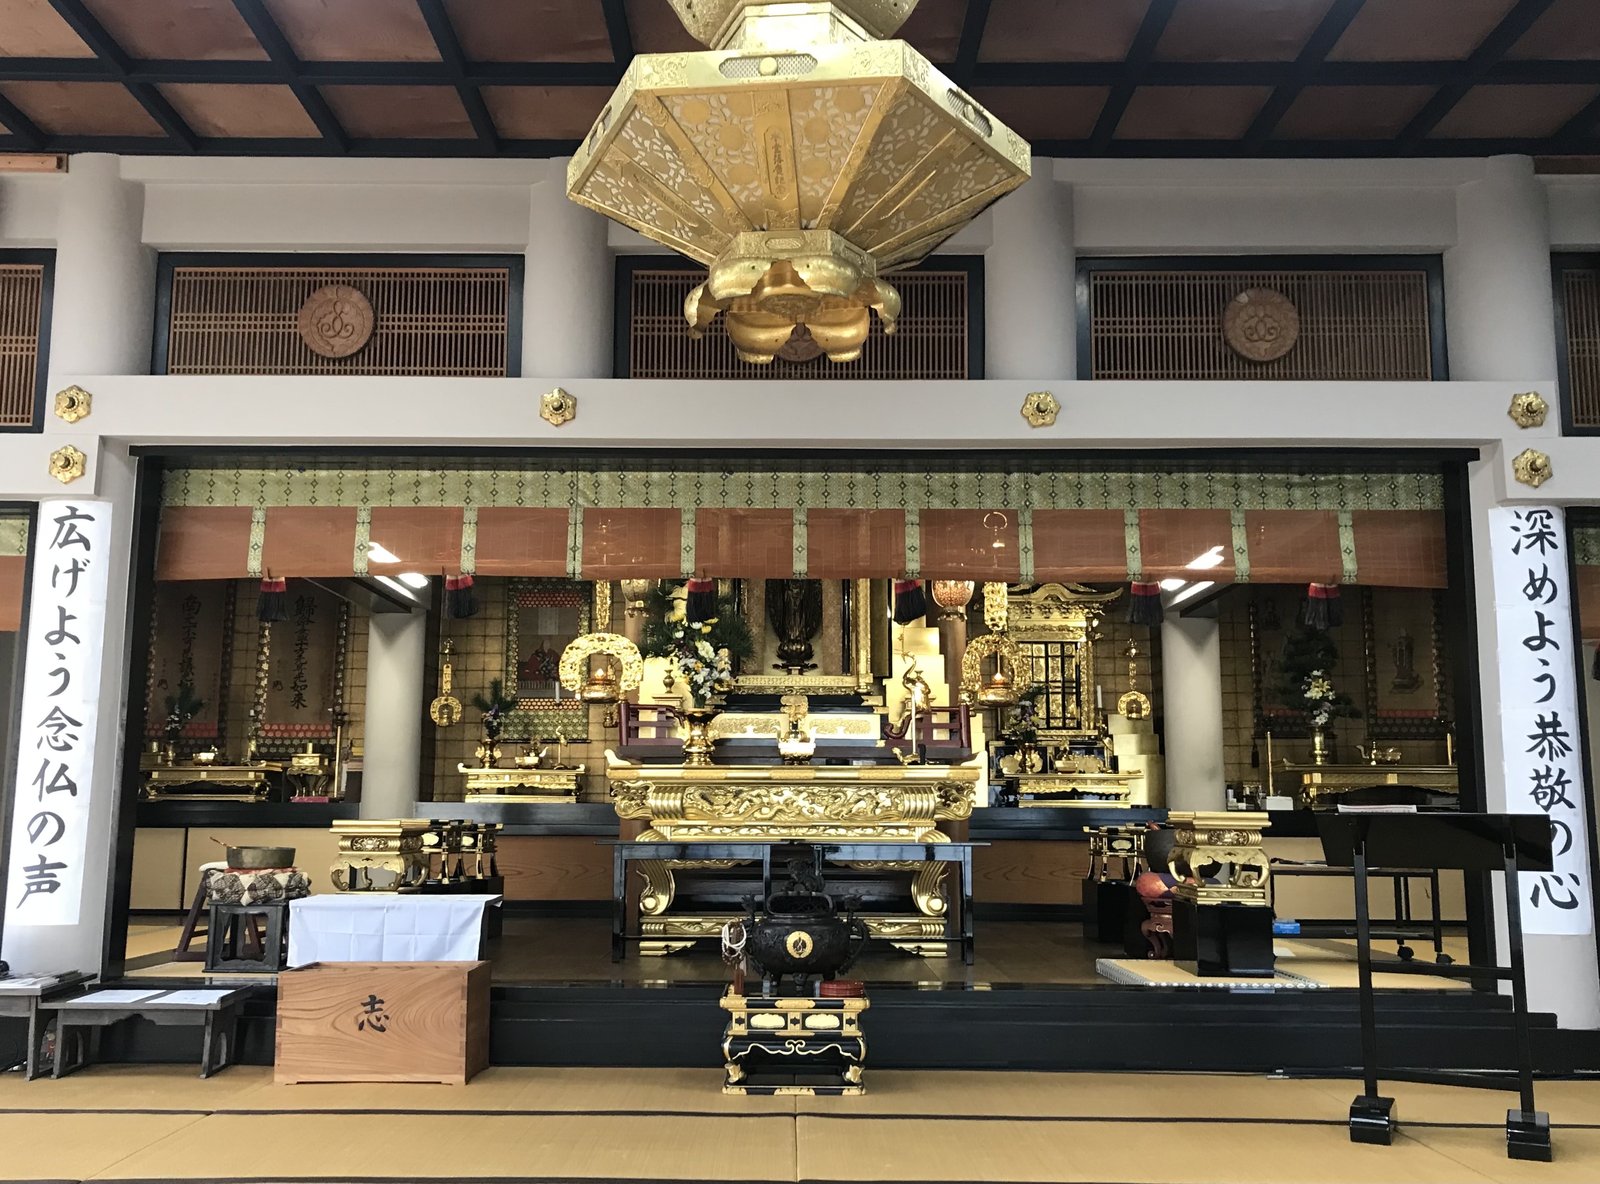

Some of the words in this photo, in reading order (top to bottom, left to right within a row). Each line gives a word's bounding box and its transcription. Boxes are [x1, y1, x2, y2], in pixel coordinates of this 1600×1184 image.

[17, 505, 96, 906] 広げよう念仏の声
[1510, 509, 1581, 911] 深めよう恭敬の心
[357, 994, 390, 1033] 志
